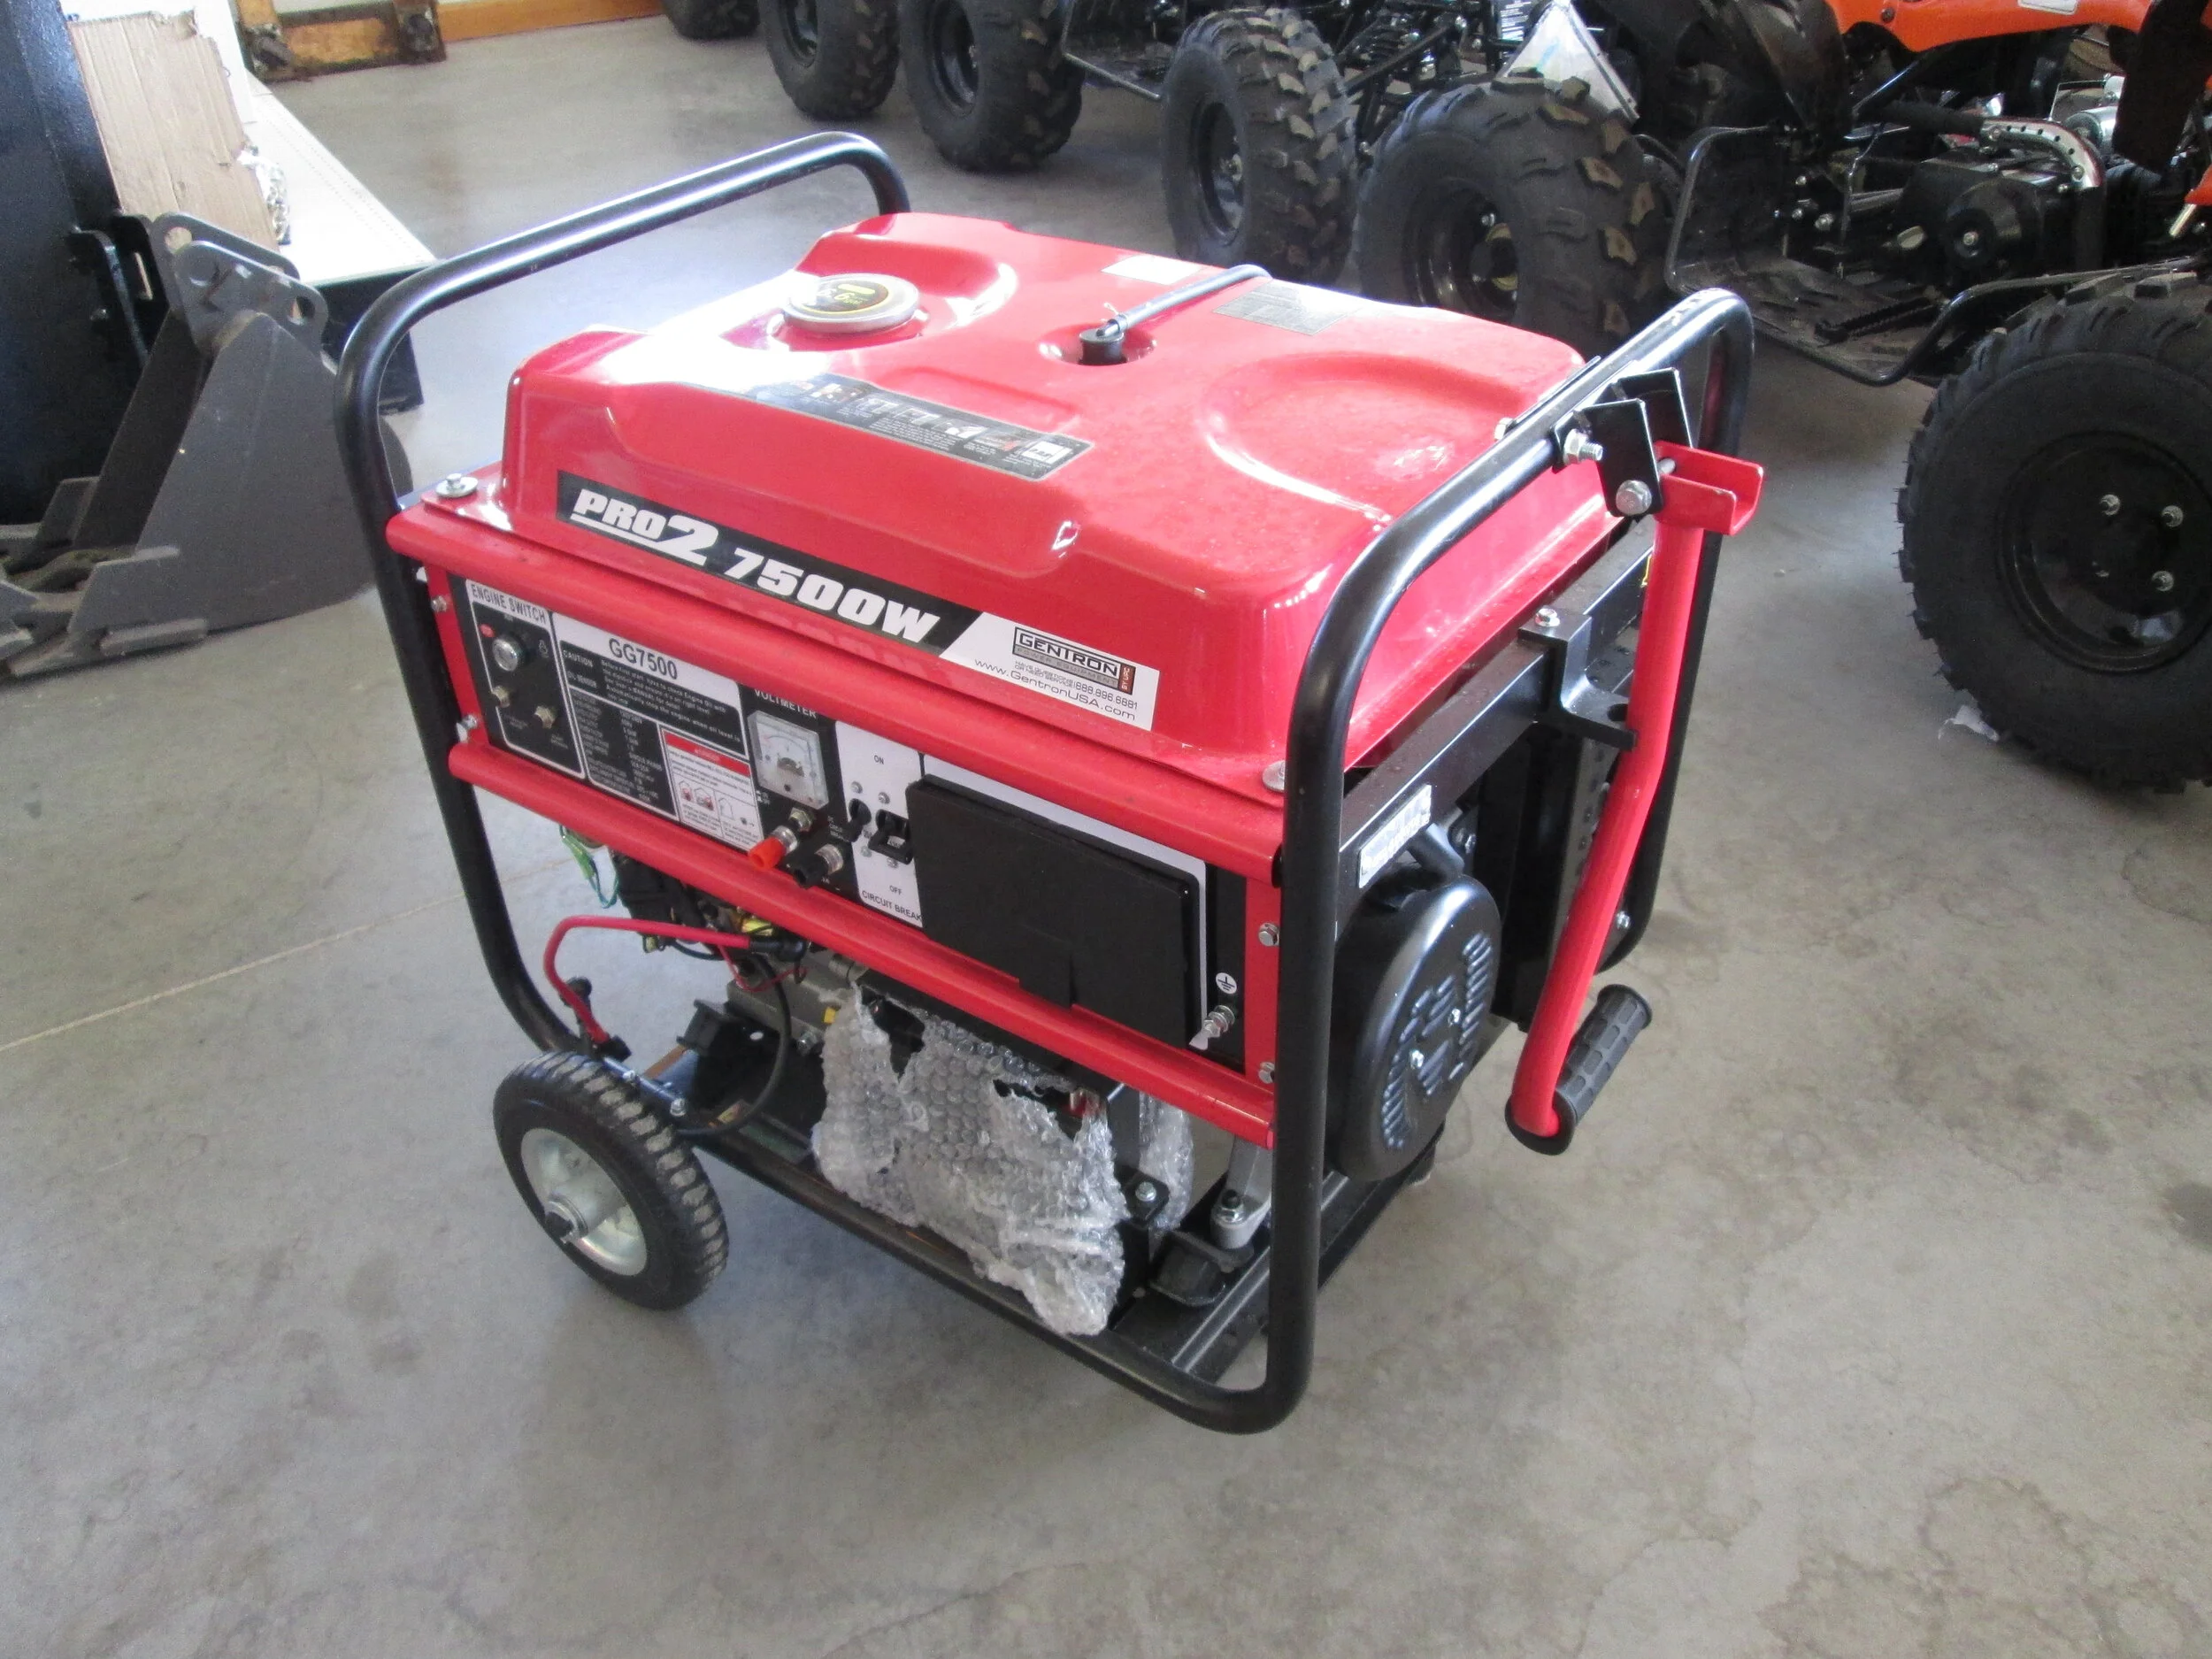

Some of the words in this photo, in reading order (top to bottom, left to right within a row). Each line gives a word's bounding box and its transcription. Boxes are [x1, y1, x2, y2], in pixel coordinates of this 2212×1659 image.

[570, 488, 718, 566] PRO2
[723, 547, 941, 643] 7500W
[471, 584, 507, 610] ENGINE
[510, 597, 548, 625] SWITCH
[563, 650, 594, 667] CAUTION
[609, 638, 678, 680] GG7500
[1019, 633, 1118, 677] GENTRON
[754, 688, 817, 719] VOLTMETER
[974, 658, 1136, 721] www.GentronUSA.com
[873, 755, 885, 765] ON
[862, 890, 893, 910] CIRCUIT
[889, 885, 902, 895] OFF
